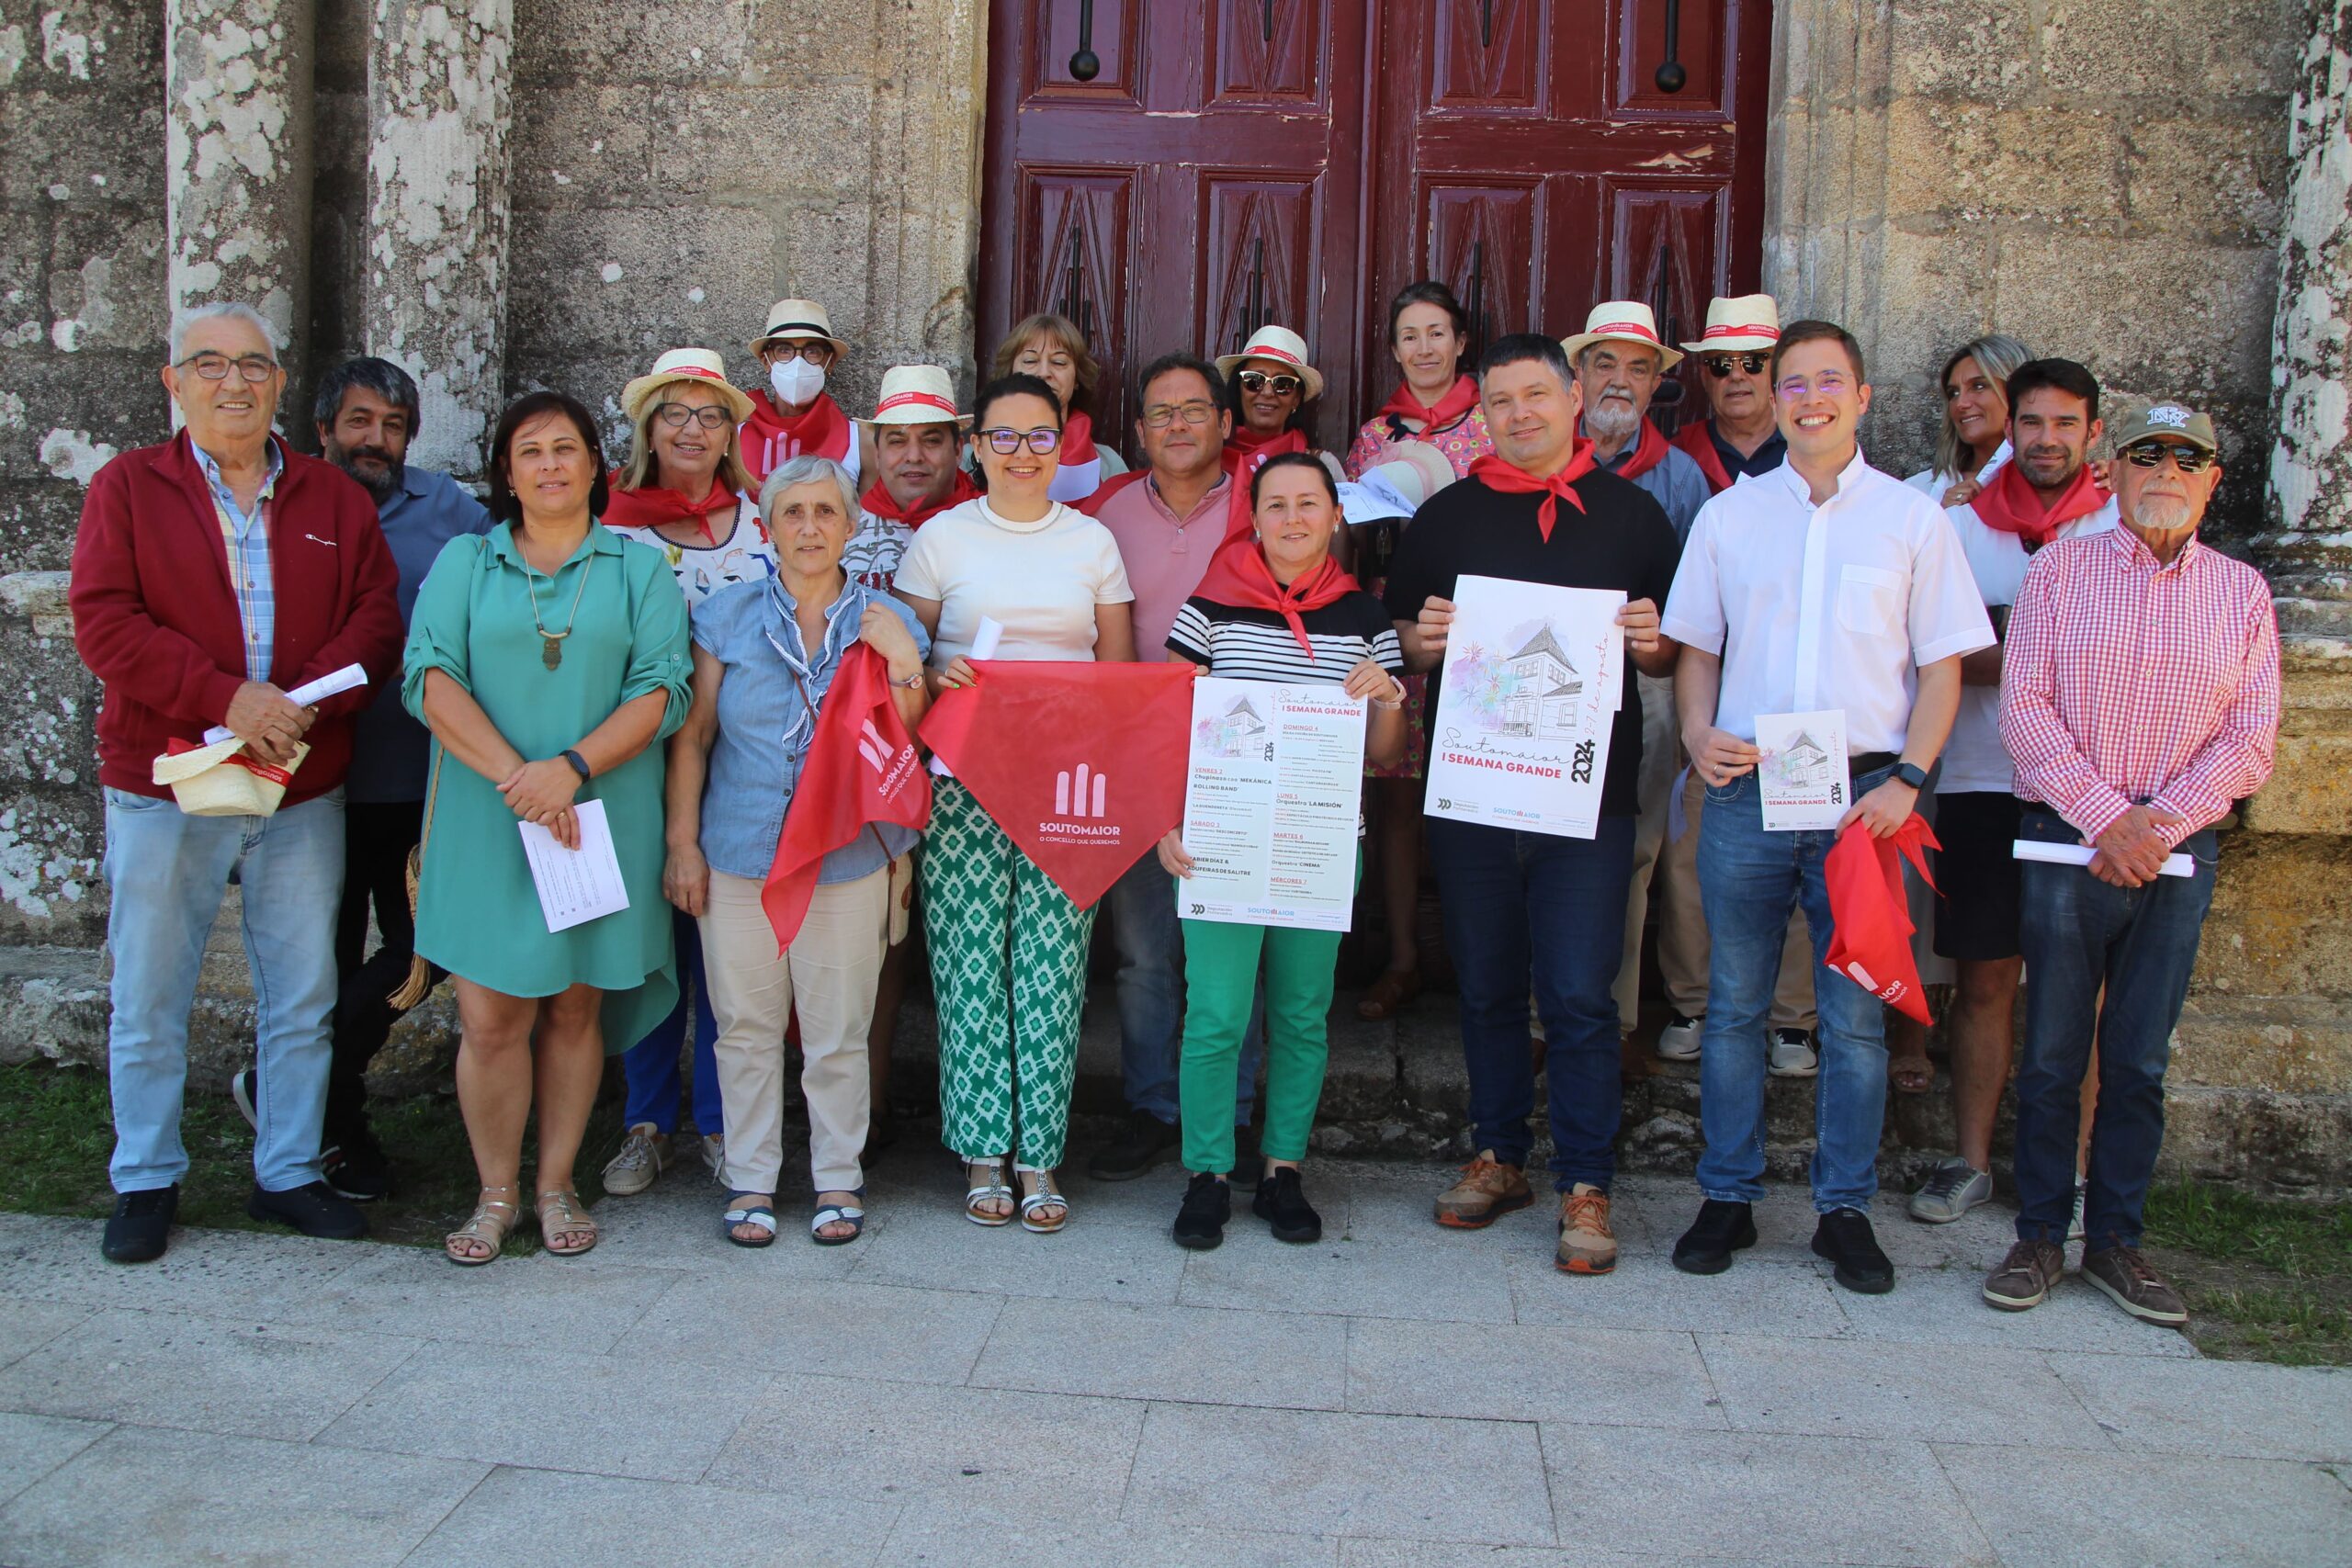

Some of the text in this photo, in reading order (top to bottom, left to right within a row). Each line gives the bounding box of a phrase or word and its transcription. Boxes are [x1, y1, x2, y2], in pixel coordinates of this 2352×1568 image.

[1588, 690, 1600, 712] de
[1595, 632, 1609, 686] agosto
[1278, 688, 1363, 707] Soutomaior
[1286, 705, 1323, 714] SEMANA
[1324, 708, 1362, 716] GRANDE
[1264, 742, 1274, 761] 2024
[1442, 727, 1570, 764] Soutomaior
[1442, 752, 1561, 779] I SEMANA GRANDE
[1571, 739, 1595, 784] 2024
[1831, 782, 1841, 804] 2024
[1040, 823, 1120, 835] SOUTOMAIOR
